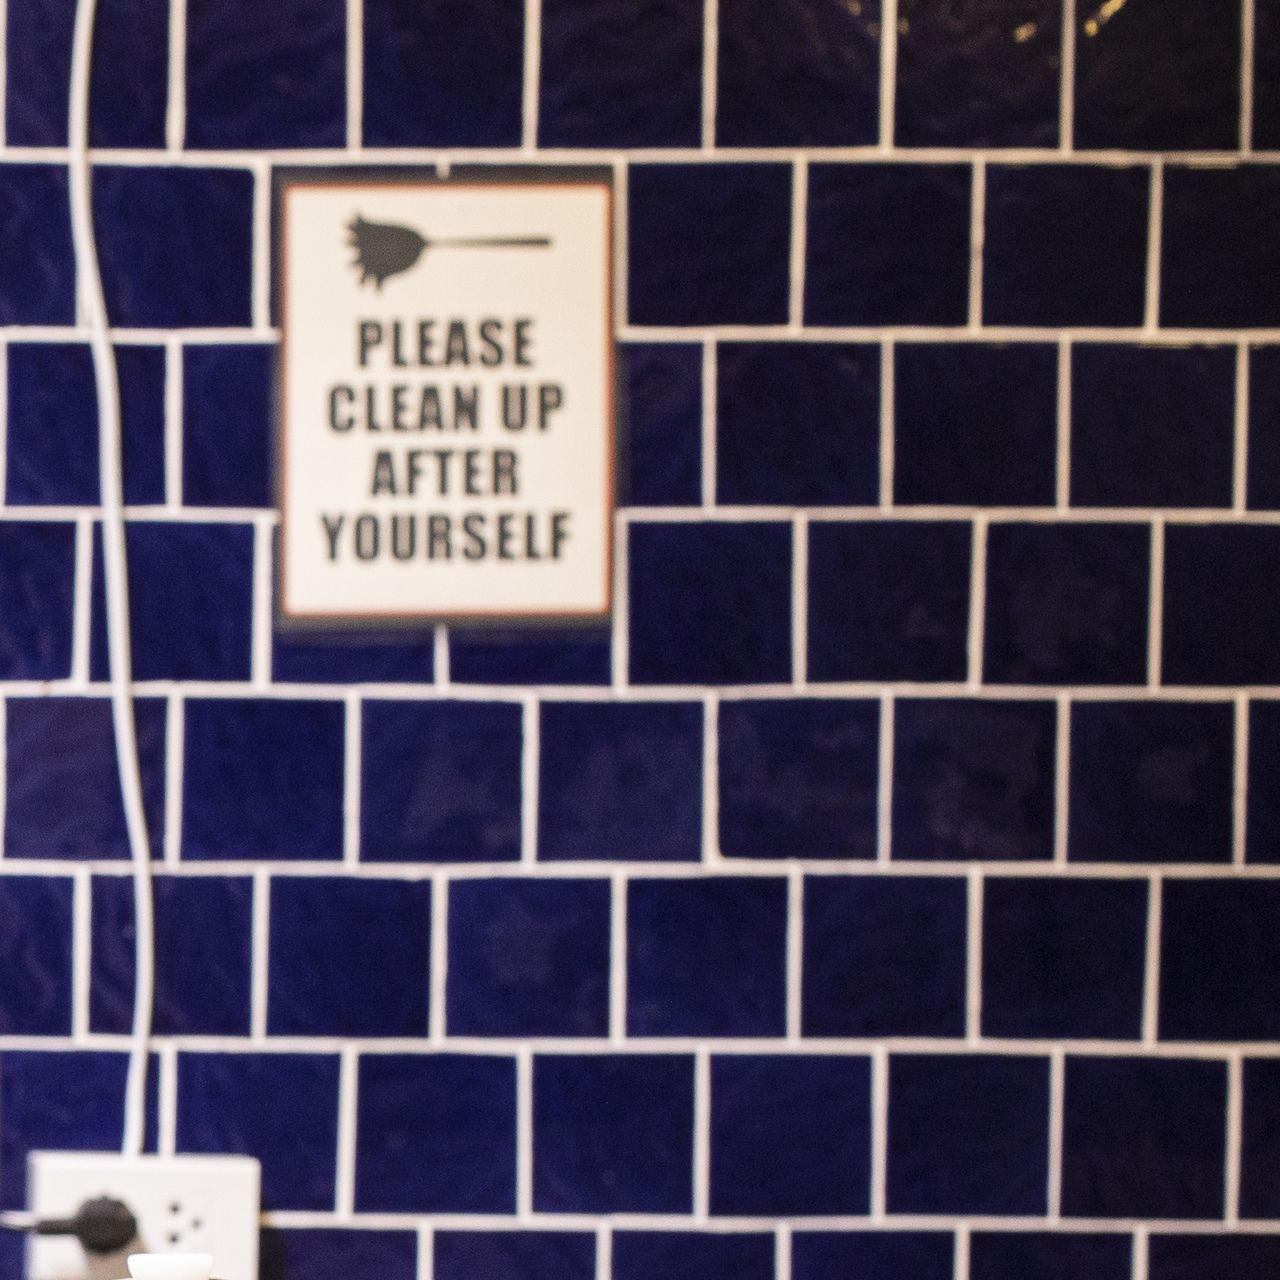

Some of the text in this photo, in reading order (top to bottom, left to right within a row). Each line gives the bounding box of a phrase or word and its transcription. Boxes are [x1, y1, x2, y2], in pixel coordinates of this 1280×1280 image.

[356, 318, 533, 367] PLEASE
[328, 383, 564, 433] CLEAN UP
[370, 448, 520, 497] AFTER
[320, 510, 572, 561] YOURSELF
